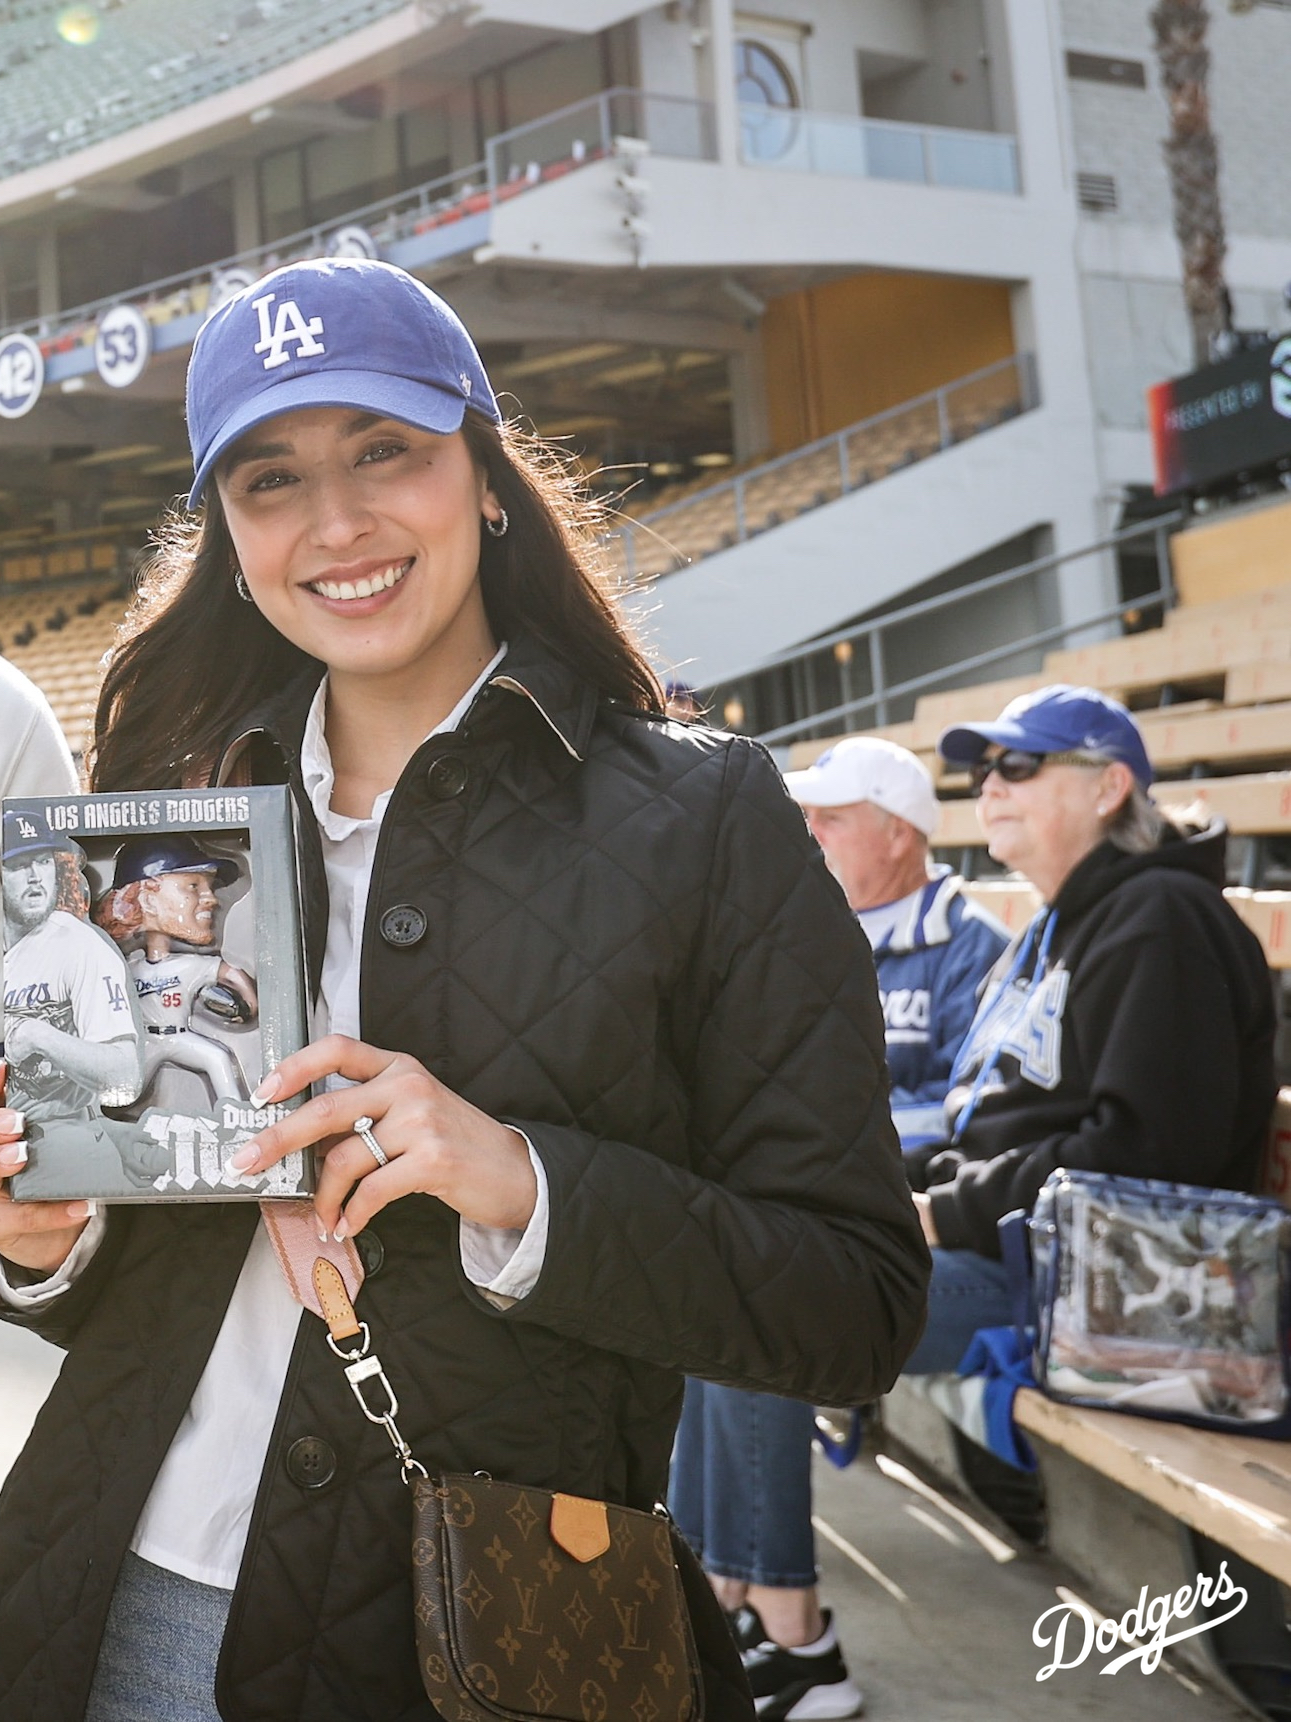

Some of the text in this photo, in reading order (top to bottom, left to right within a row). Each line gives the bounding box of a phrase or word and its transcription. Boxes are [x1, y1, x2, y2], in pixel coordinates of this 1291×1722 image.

[104, 325, 138, 366] 53
[252, 293, 325, 370] LA
[45, 796, 250, 831] LOS ANGELES DODGERS
